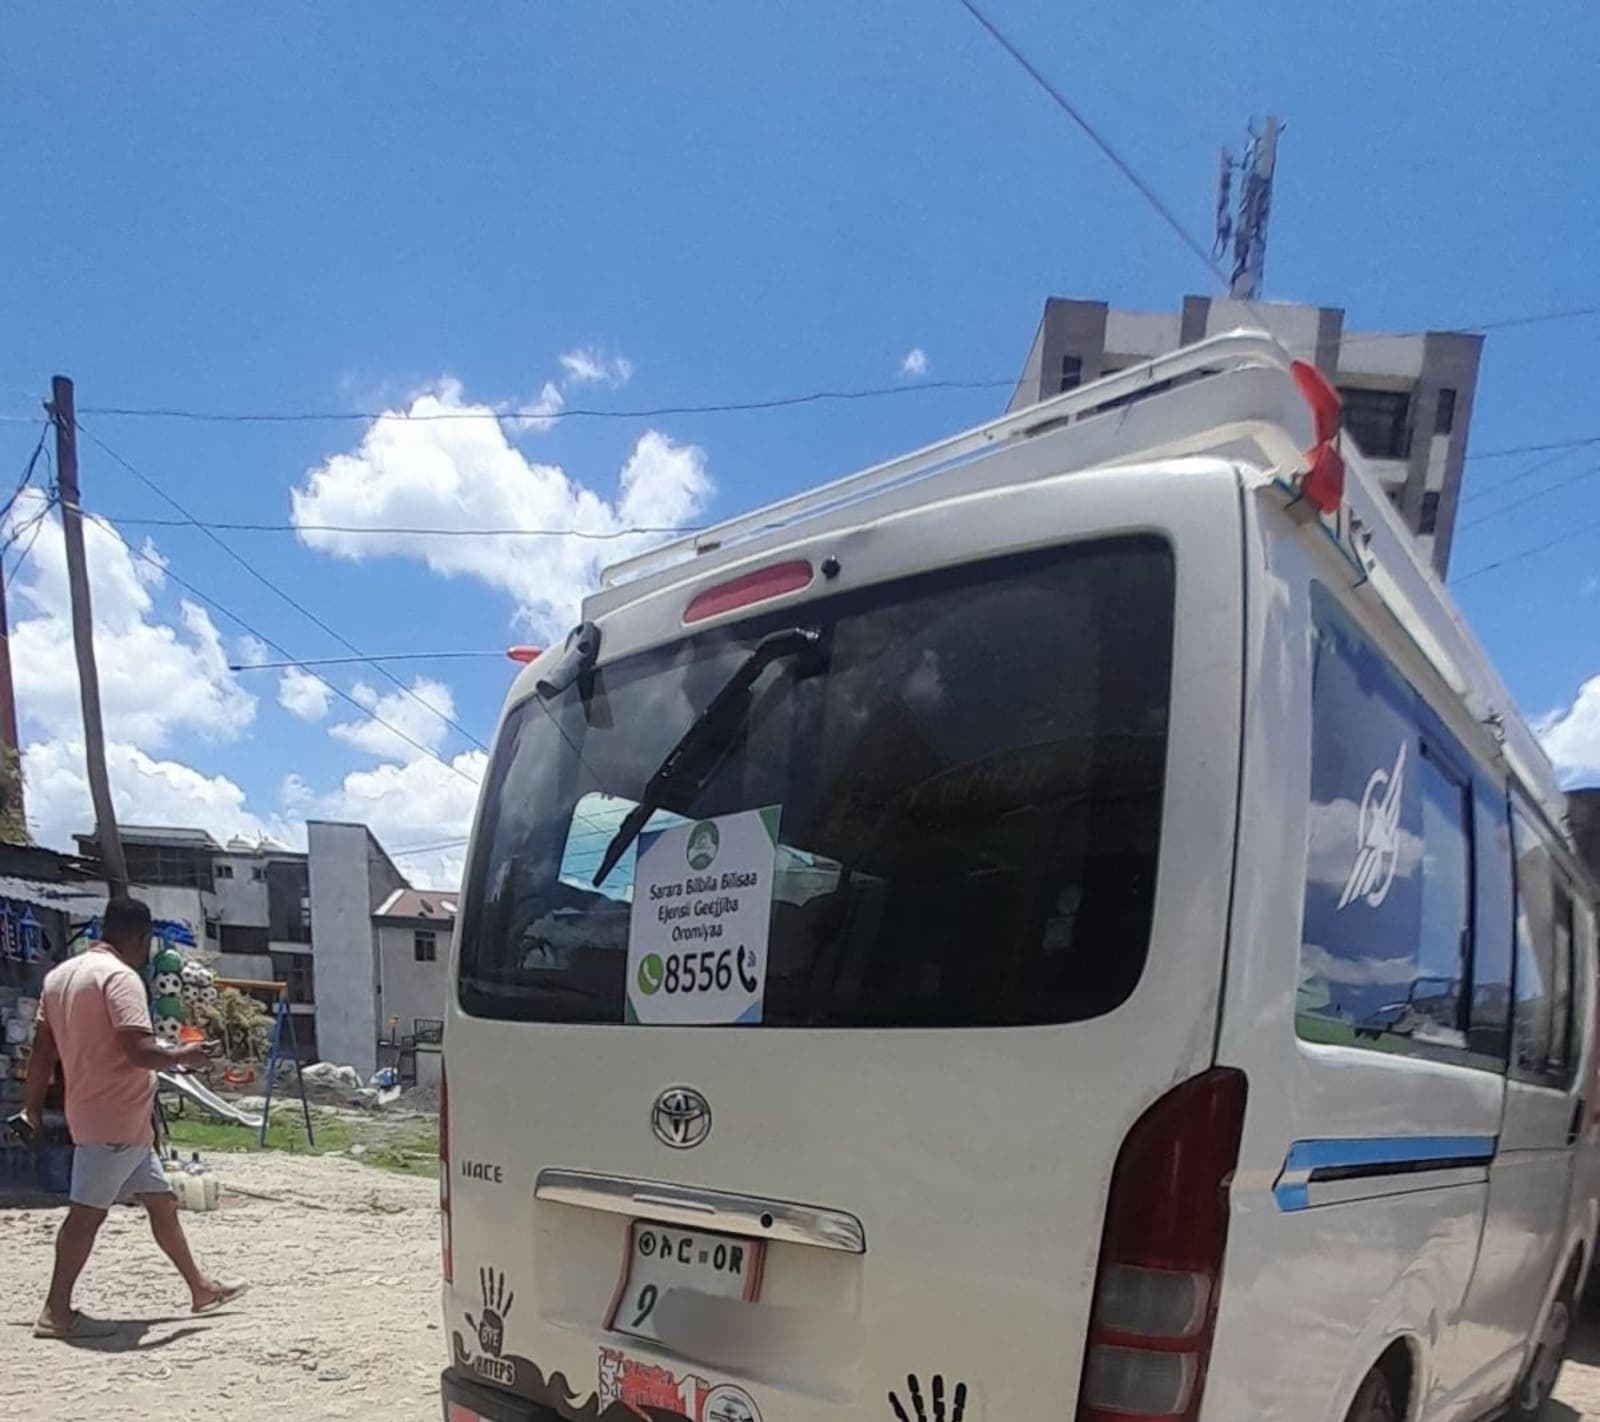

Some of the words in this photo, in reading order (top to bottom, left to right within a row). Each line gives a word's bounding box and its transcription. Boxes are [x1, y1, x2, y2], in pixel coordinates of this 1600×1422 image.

[650, 884, 682, 900] Sarara
[672, 924, 723, 942] Oromiyaa
[665, 949, 732, 994] 8556
[713, 1244, 743, 1275] OR
